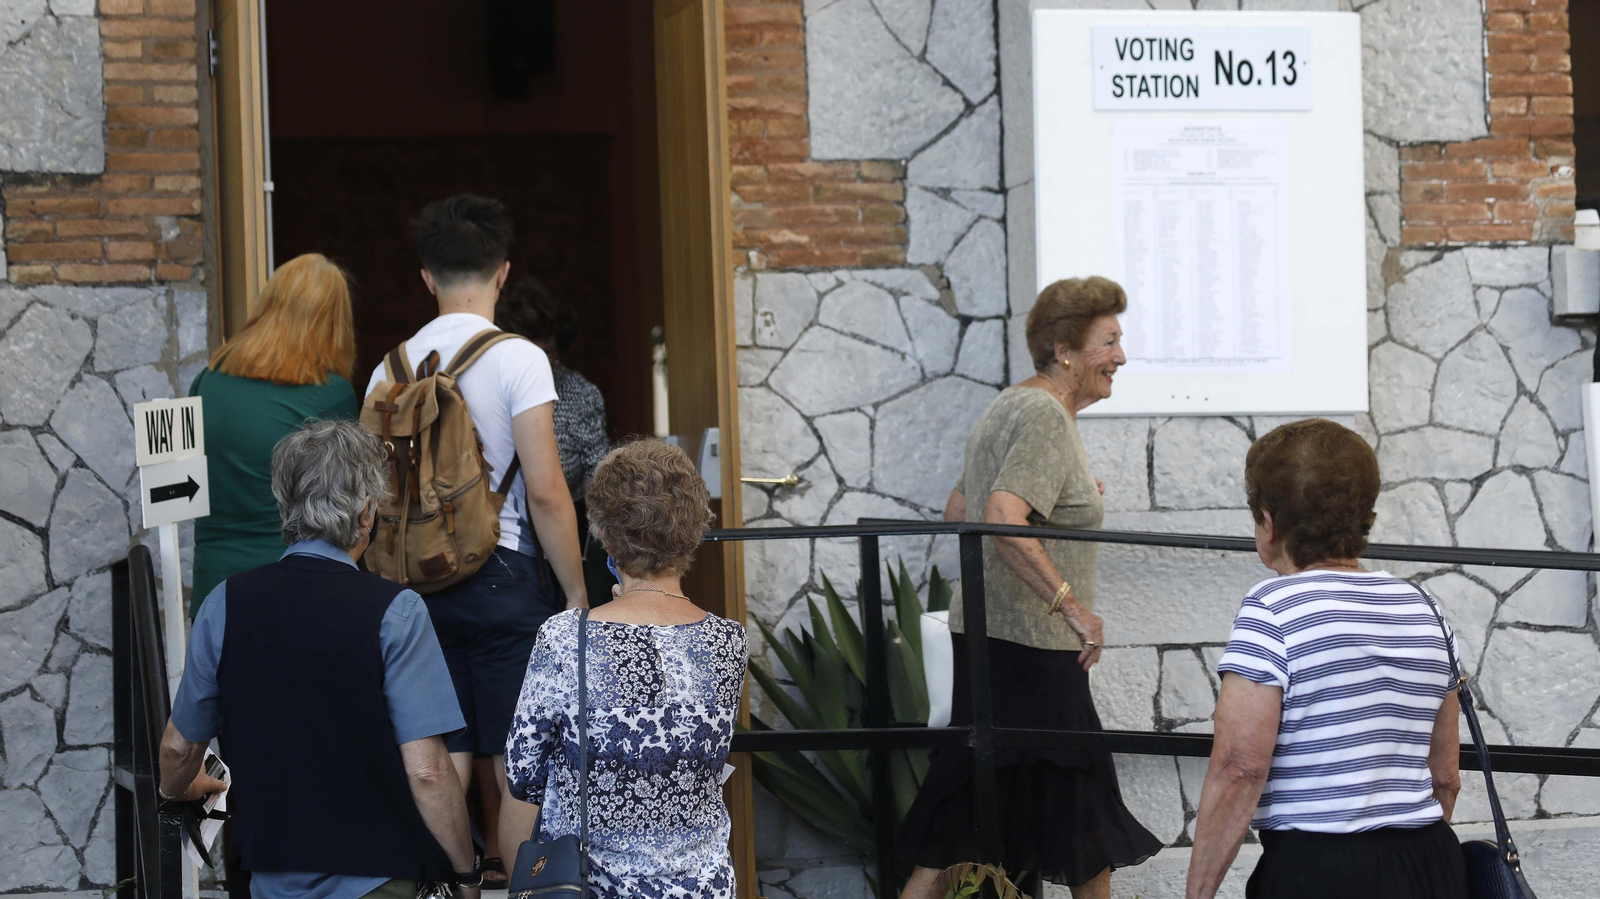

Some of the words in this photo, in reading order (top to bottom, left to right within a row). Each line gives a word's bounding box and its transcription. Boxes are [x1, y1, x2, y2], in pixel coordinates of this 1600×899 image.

[1115, 37, 1194, 62] VOTING
[1214, 49, 1298, 86] No.13
[1112, 74, 1199, 98] STATION
[145, 408, 174, 455] WAY
[181, 406, 196, 450] IN
